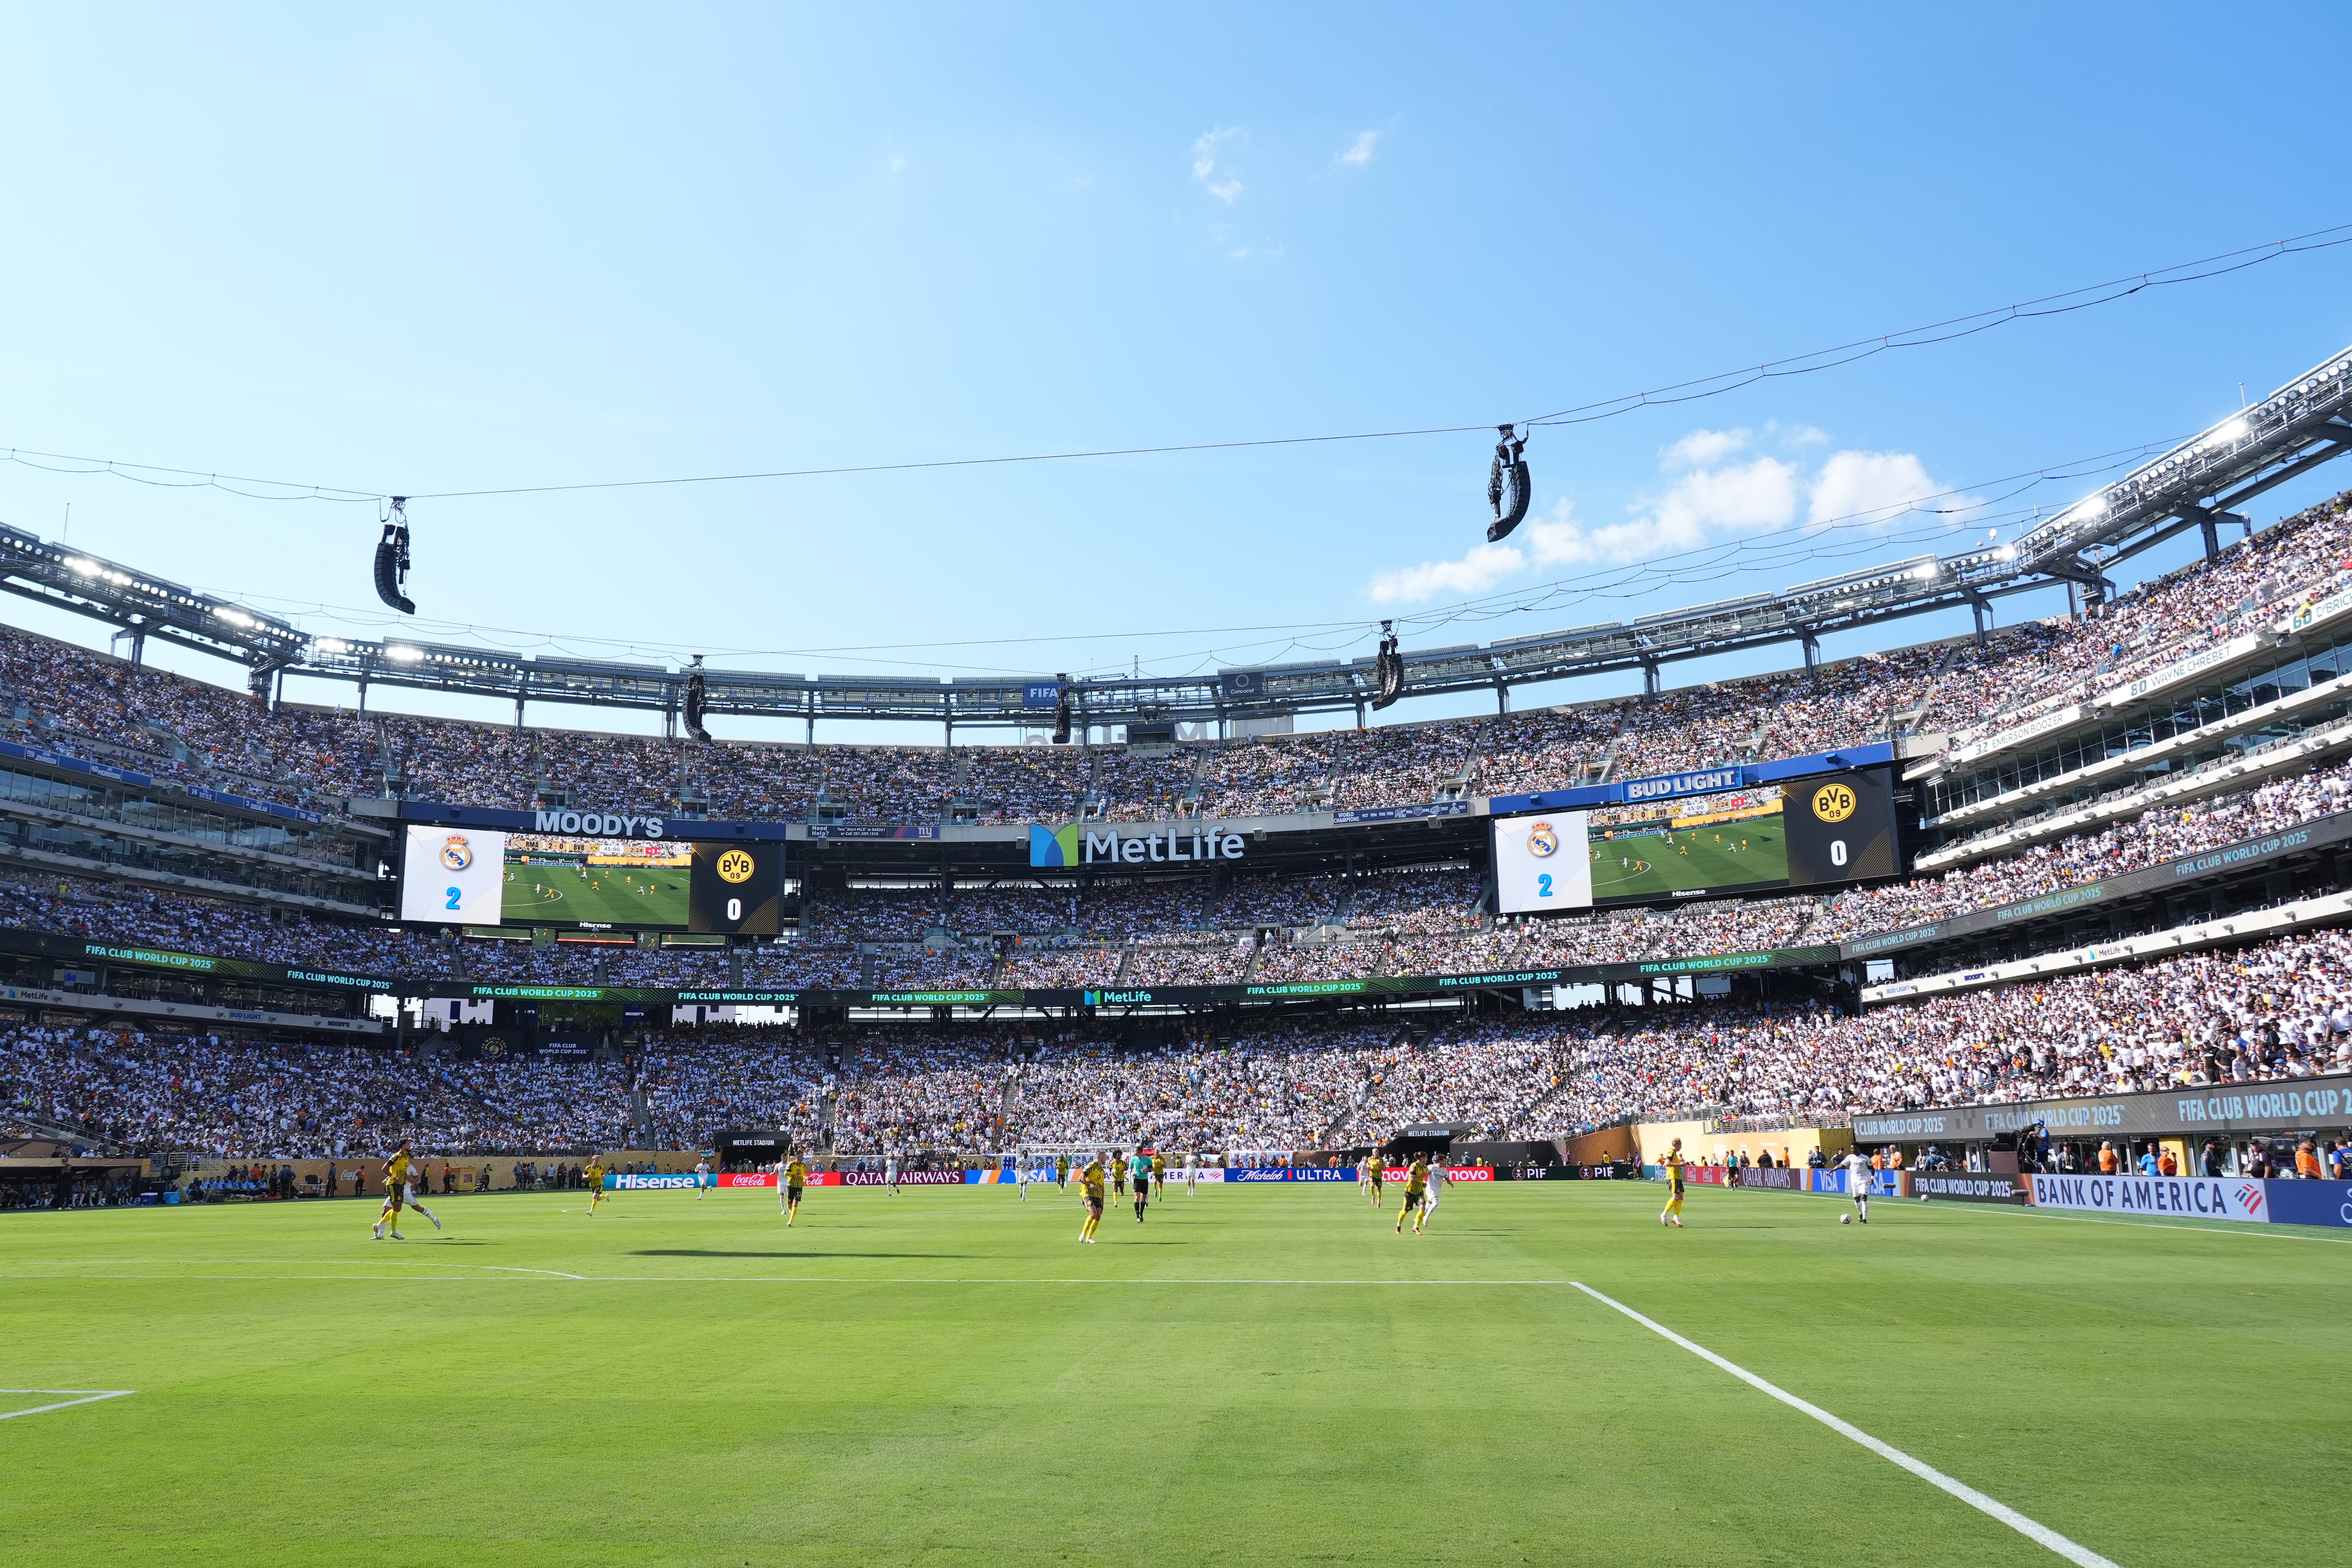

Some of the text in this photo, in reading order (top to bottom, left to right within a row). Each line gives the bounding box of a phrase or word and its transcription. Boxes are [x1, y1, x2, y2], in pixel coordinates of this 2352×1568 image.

[2131, 646, 2231, 696] 80 WAYNE CHREBET
[1030, 688, 1058, 697] FIFA
[1992, 727, 2029, 748] EMERSON
[2031, 714, 2063, 734] BOOZER
[34, 755, 57, 765] JOHNSON
[98, 769, 120, 780] MORRISON
[1629, 779, 1671, 798] BUD
[250, 803, 268, 812] GOGOLAK
[1819, 788, 1851, 812] BVB
[535, 811, 663, 838] MOODY'S
[1086, 825, 1245, 863] MetLife
[1831, 840, 1847, 866] 0
[723, 854, 749, 873] BVB
[2176, 862, 2196, 876] FIFA
[2197, 855, 2222, 870] CLUB
[2223, 845, 2259, 863] WORLD
[2260, 839, 2280, 854] CUP
[1538, 874, 1552, 896] 2
[1672, 889, 1706, 897] Hisense
[445, 887, 461, 910] 2
[1997, 910, 2012, 921] FIFA
[2014, 904, 2033, 917] CLUB
[2034, 897, 2061, 912] WORLD
[2063, 893, 2079, 906] CUP
[727, 898, 741, 920] 0
[1852, 943, 1865, 953] FIFA
[1866, 939, 1881, 950] CLUB
[1882, 934, 1904, 946] WORLD
[1905, 932, 1917, 941] CUP
[86, 945, 106, 956] FIFA
[108, 948, 133, 959] CLUB
[135, 951, 168, 964] WORLD
[170, 956, 188, 966] CUP
[2099, 947, 2121, 958] MetLife
[21, 991, 48, 1000] MetLife
[520, 989, 554, 997] WORLD
[1104, 991, 1152, 1003] MetLife
[1896, 985, 1910, 993] LIGHT
[2178, 1099, 2207, 1121] FIFA
[2208, 1096, 2244, 1120] CLUB
[2244, 1092, 2302, 1118] WORLD
[2304, 1089, 2338, 1116] CUP
[1859, 1121, 1878, 1136] CLUB
[1880, 1118, 1906, 1135] WORLD
[1906, 1118, 1920, 1134] CUP
[1986, 1113, 2004, 1130] FIFA
[2006, 1111, 2030, 1129] CLUB
[2069, 1107, 2090, 1126] CUP
[616, 1175, 695, 1189] Hisense
[732, 1174, 767, 1186] Coca-Cola
[899, 1171, 960, 1184] AIRWAYS
[1237, 1170, 1342, 1181] Michelob ULTRA
[1527, 1169, 1547, 1179] PIF
[1595, 1167, 1614, 1178] PIF
[1743, 1168, 1763, 1187] QATAR
[1764, 1169, 1790, 1188] AIRWAYS
[1819, 1170, 1839, 1192] VISA
[1915, 1178, 1929, 1192] FIFA
[1929, 1179, 1947, 1194] CLUB
[1947, 1180, 1974, 1196] WORLD
[1974, 1180, 1990, 1196] CUP
[2037, 1178, 2227, 1214] BANK OF AMERICA
